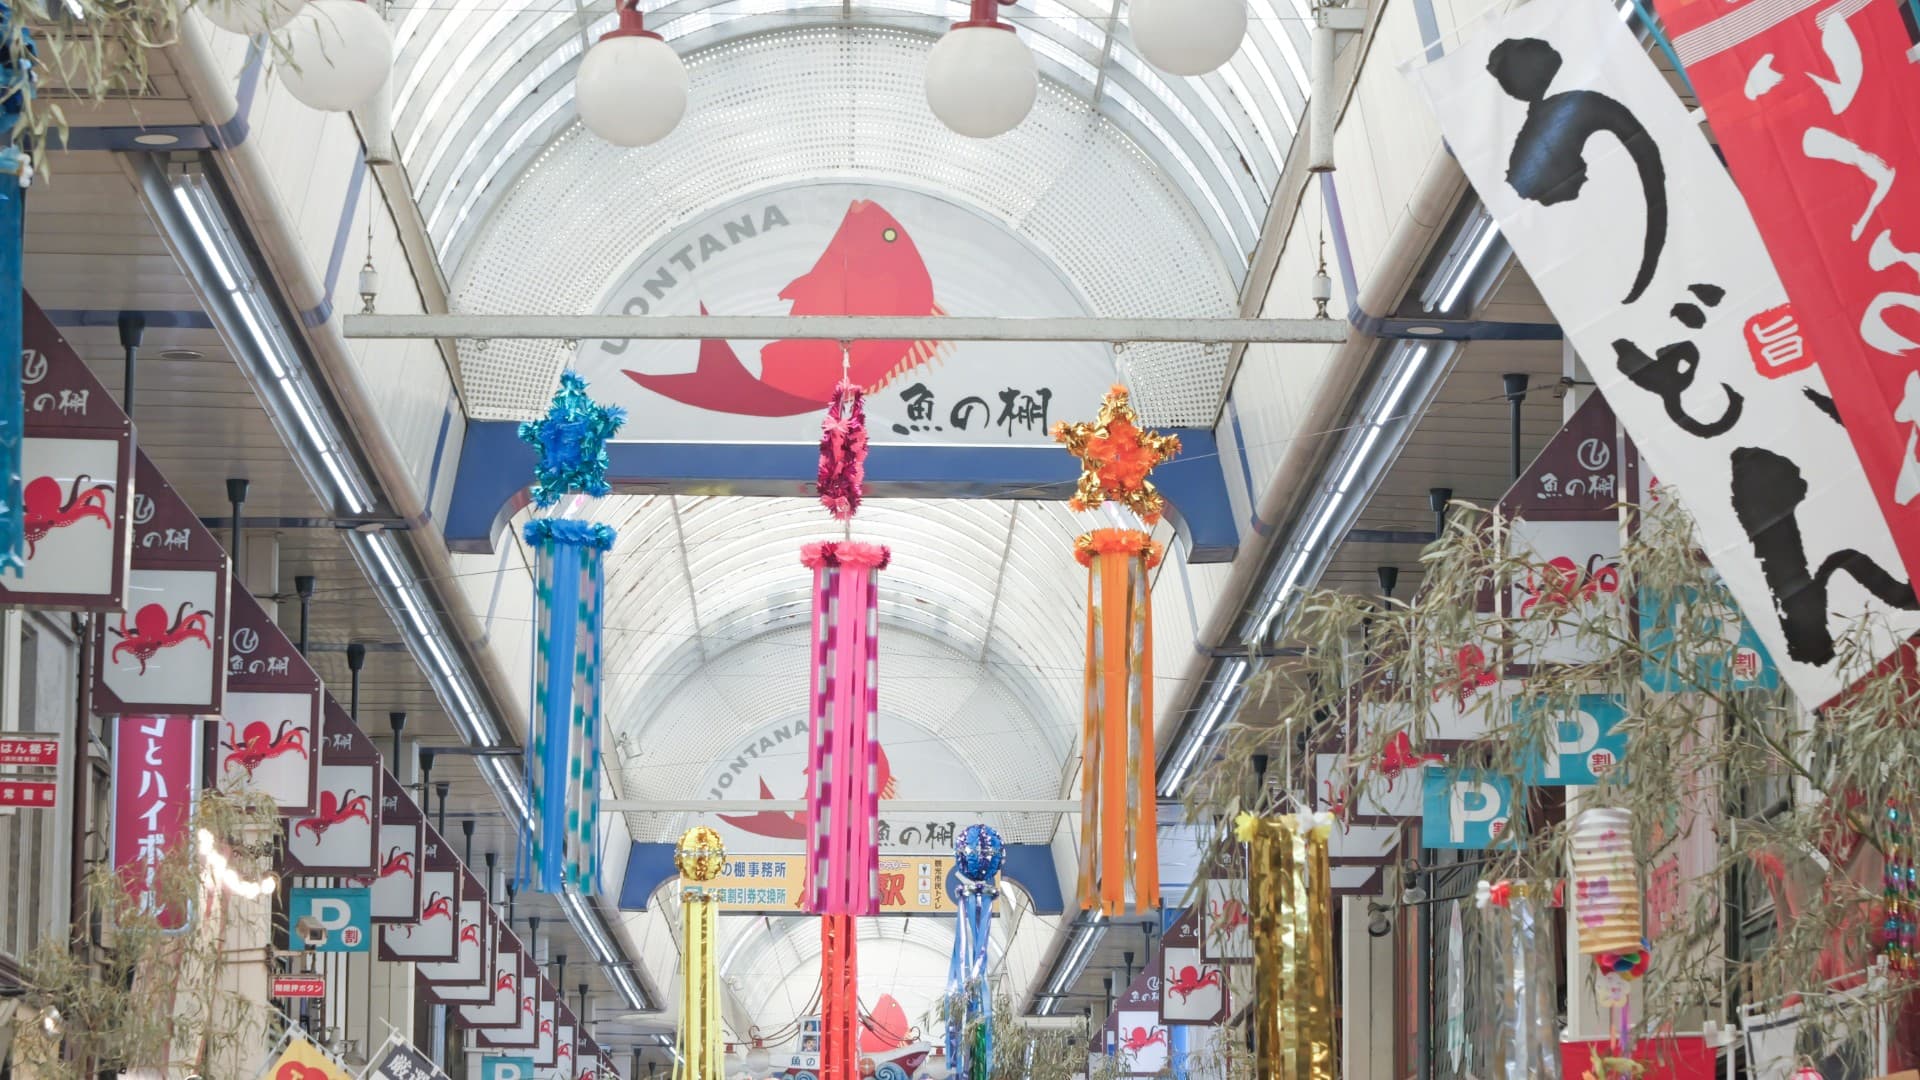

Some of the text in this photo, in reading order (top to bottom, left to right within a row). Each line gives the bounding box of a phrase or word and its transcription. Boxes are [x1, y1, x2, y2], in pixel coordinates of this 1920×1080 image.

[23, 389, 90, 415] の棚
[891, 382, 1053, 437] 魚の棚
[1537, 472, 1616, 499] 魚の棚
[1543, 709, 1600, 779] P
[1448, 780, 1501, 844] P
[311, 898, 352, 947] P
